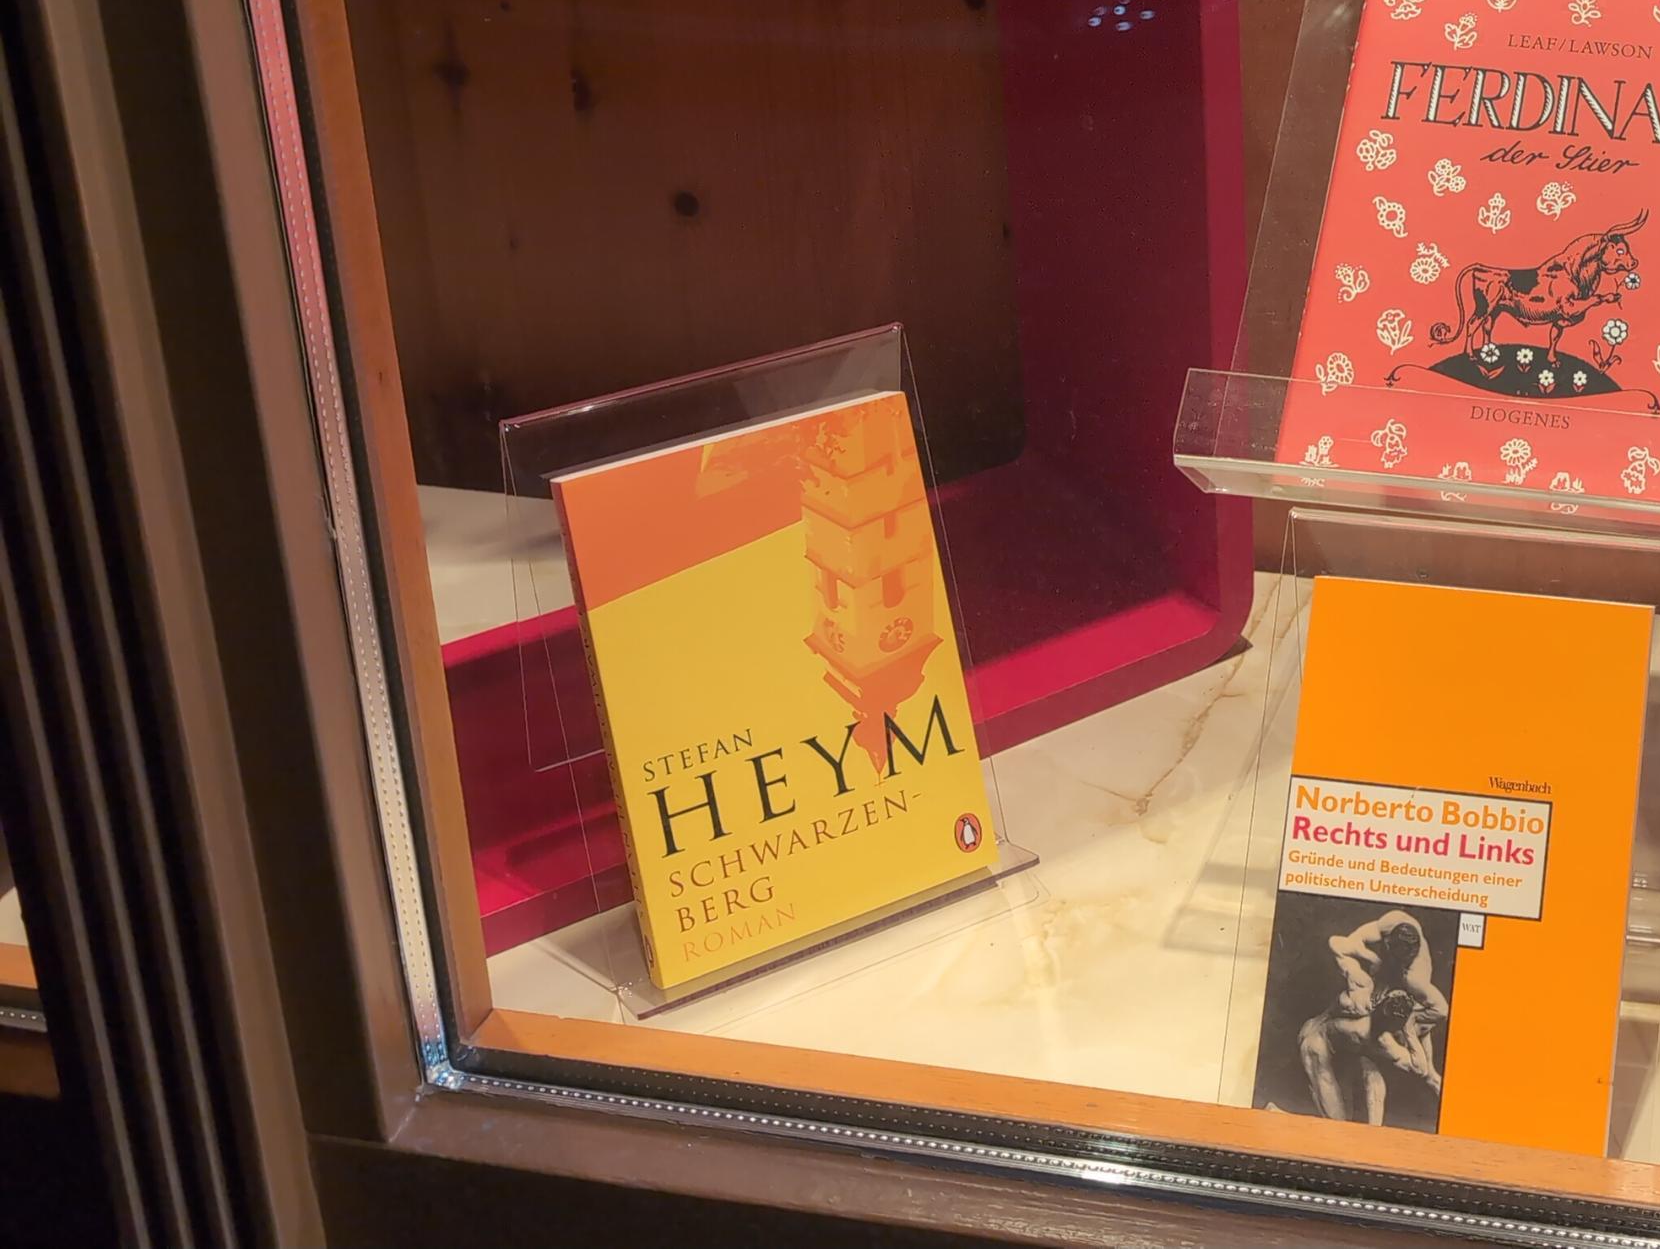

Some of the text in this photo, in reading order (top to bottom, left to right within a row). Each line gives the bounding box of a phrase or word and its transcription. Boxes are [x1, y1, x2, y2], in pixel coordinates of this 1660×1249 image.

[1507, 34, 1654, 60] LEAF/LAWSON
[1479, 141, 1640, 174] der Stier
[1470, 405, 1572, 430] DIOGENES
[643, 728, 753, 783] STEFAN
[647, 693, 966, 859] HEYM
[1295, 784, 1545, 835] Norberto Bobbio
[1488, 776, 1552, 795] Wagenbach
[668, 789, 922, 898] SCHWARZEN-
[1292, 815, 1536, 866] Rechts und Links
[1285, 871, 1489, 908] politischen Unterscheidung
[1288, 849, 1523, 888] Gründe und Bedeutungen einer
[675, 876, 776, 934] BERG
[682, 902, 796, 963] ROMAN
